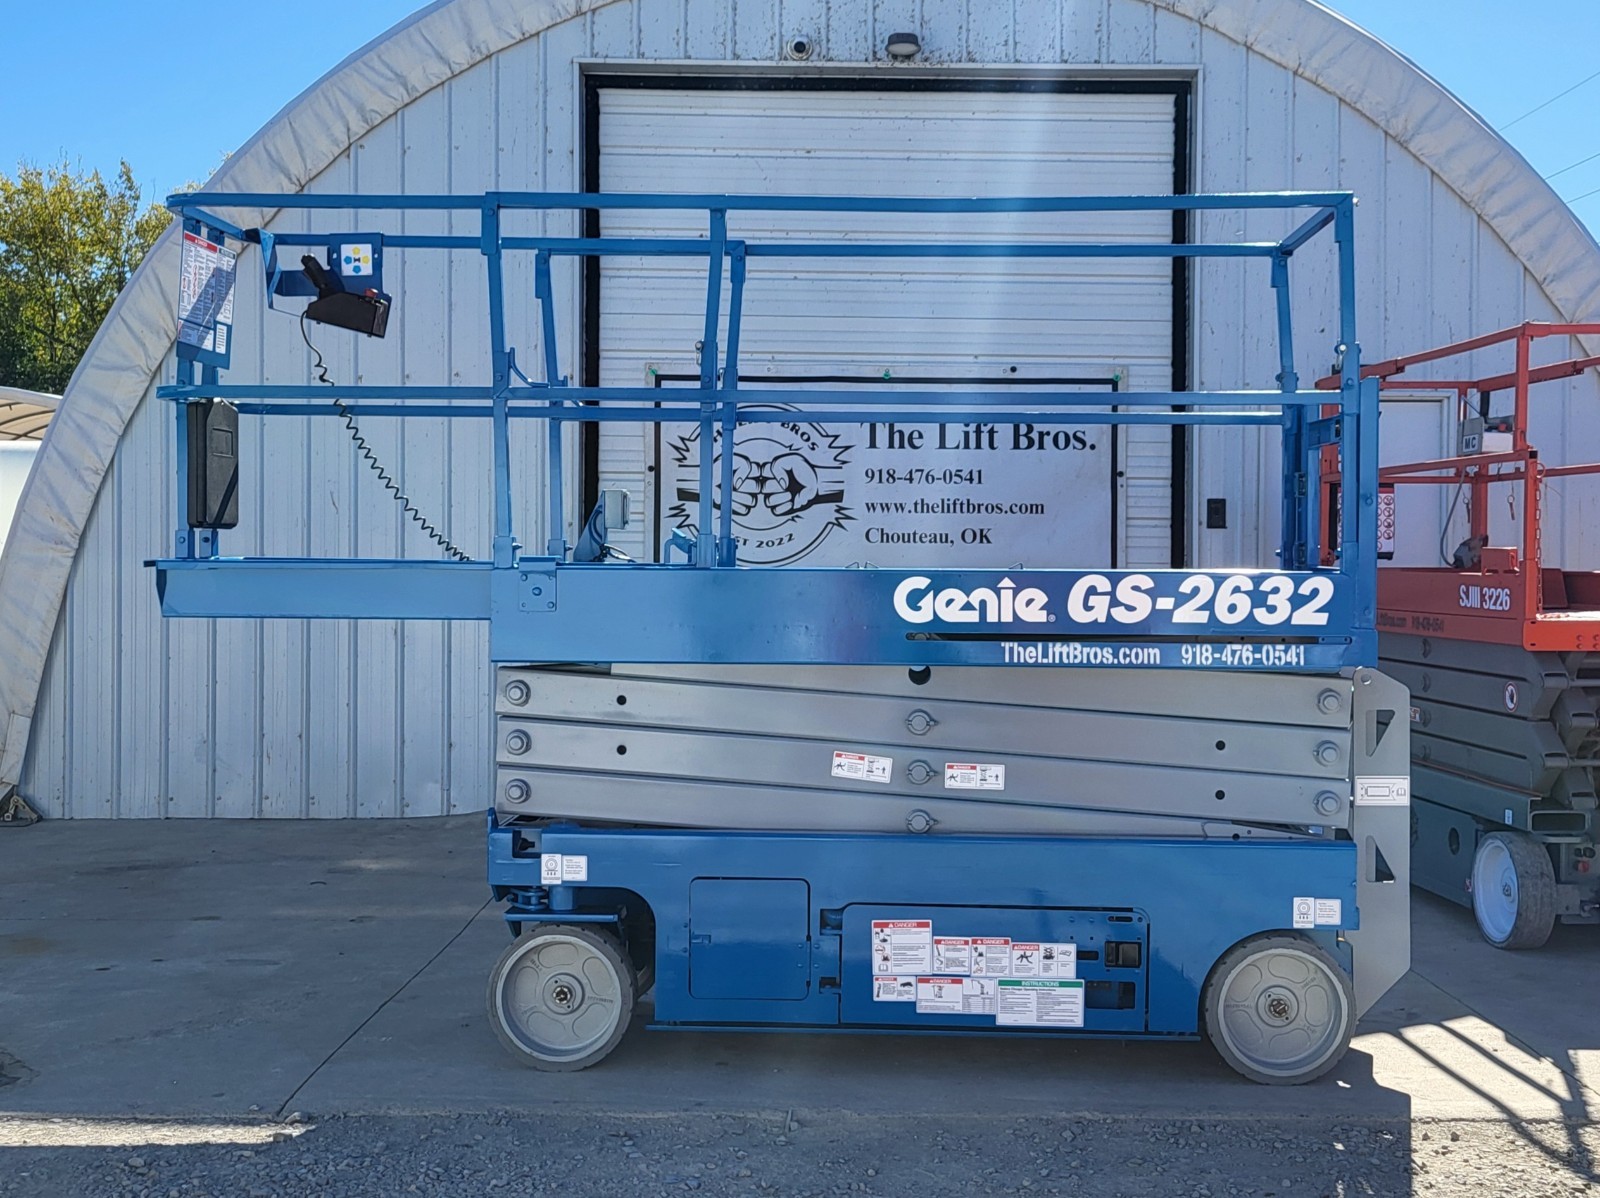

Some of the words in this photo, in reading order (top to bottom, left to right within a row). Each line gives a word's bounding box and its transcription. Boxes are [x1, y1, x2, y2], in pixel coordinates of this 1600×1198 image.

[780, 421, 820, 452] BROS
[860, 422, 924, 450] The
[935, 422, 1000, 450] Lift
[1009, 422, 1097, 451] Bros.
[1464, 436, 1477, 450] MC
[864, 467, 984, 485] 918-476-0541
[865, 497, 1046, 515] www.theliftbros.com
[754, 532, 796, 549] 2022
[864, 527, 955, 547] Chouteau,
[960, 527, 993, 545] OK
[893, 576, 1049, 624] Genie
[1067, 573, 1335, 626] GS-2632
[1482, 586, 1511, 611] 3226
[1000, 641, 1161, 665] TheLiftBros.com
[1181, 643, 1305, 667] 918-476-0541
